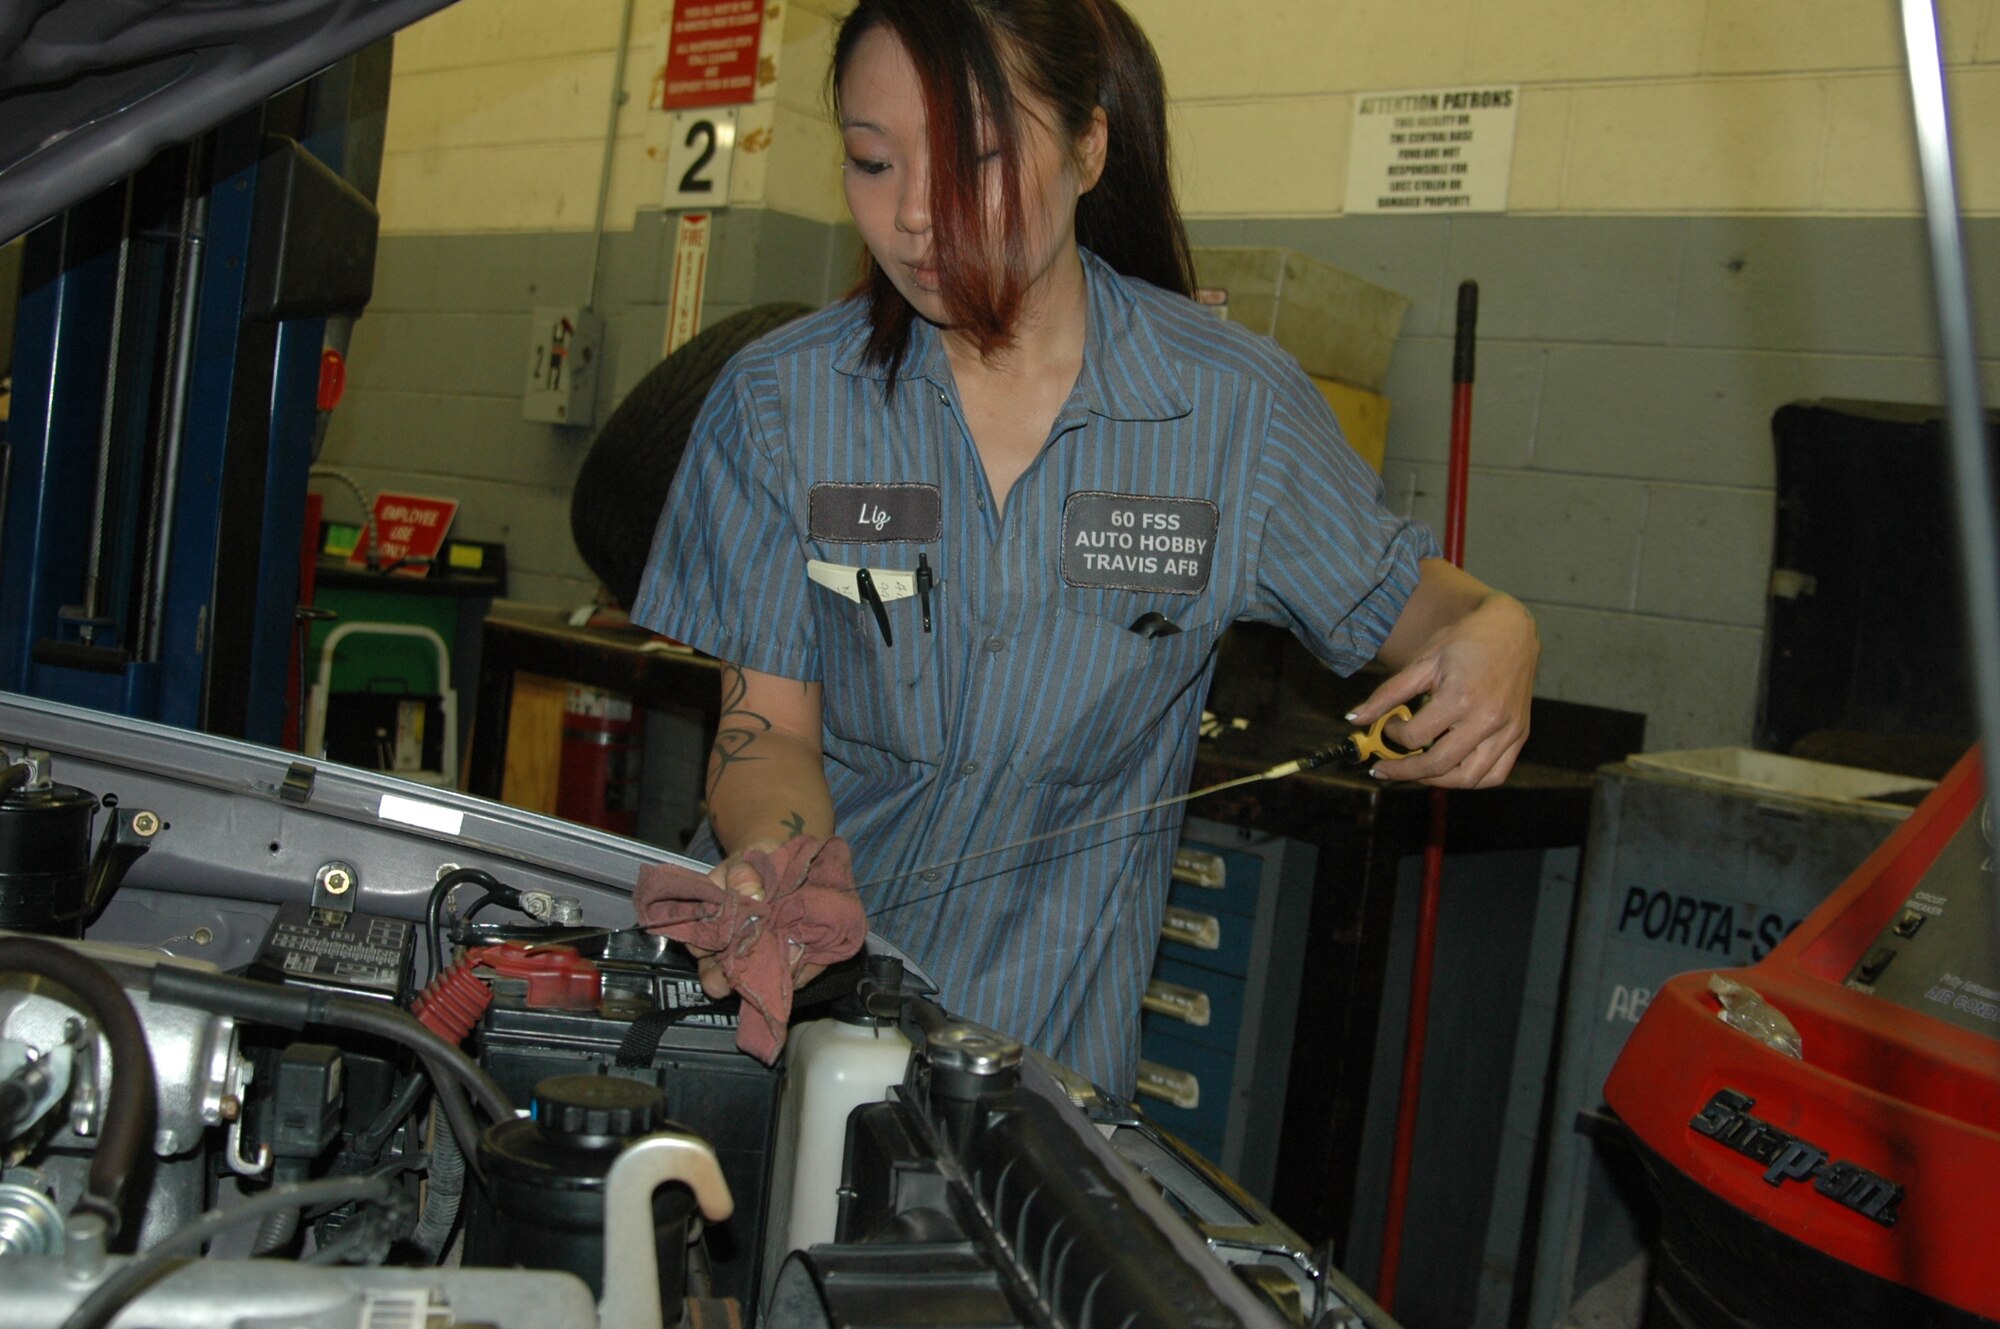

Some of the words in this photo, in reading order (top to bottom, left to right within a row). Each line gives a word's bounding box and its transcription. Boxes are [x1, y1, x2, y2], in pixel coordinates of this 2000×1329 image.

[1359, 95, 1439, 115] ATTENTION
[1443, 90, 1513, 110] PATRONS
[678, 120, 716, 192] 2
[1387, 164, 1448, 176] RESPONSIBLE
[1450, 163, 1468, 174] FOR
[682, 228, 705, 247] FIRE
[381, 505, 440, 527] EMPLOYEE
[858, 503, 891, 531] Liz
[1111, 510, 1135, 528] 60
[1142, 513, 1181, 530] FSS
[389, 525, 414, 543] USE
[1075, 530, 1133, 549] AUTO
[1140, 534, 1207, 555] HOBBY
[1083, 553, 1158, 573] TRAVIS
[1163, 558, 1199, 577] AFB
[1924, 986, 1955, 1005] AIR
